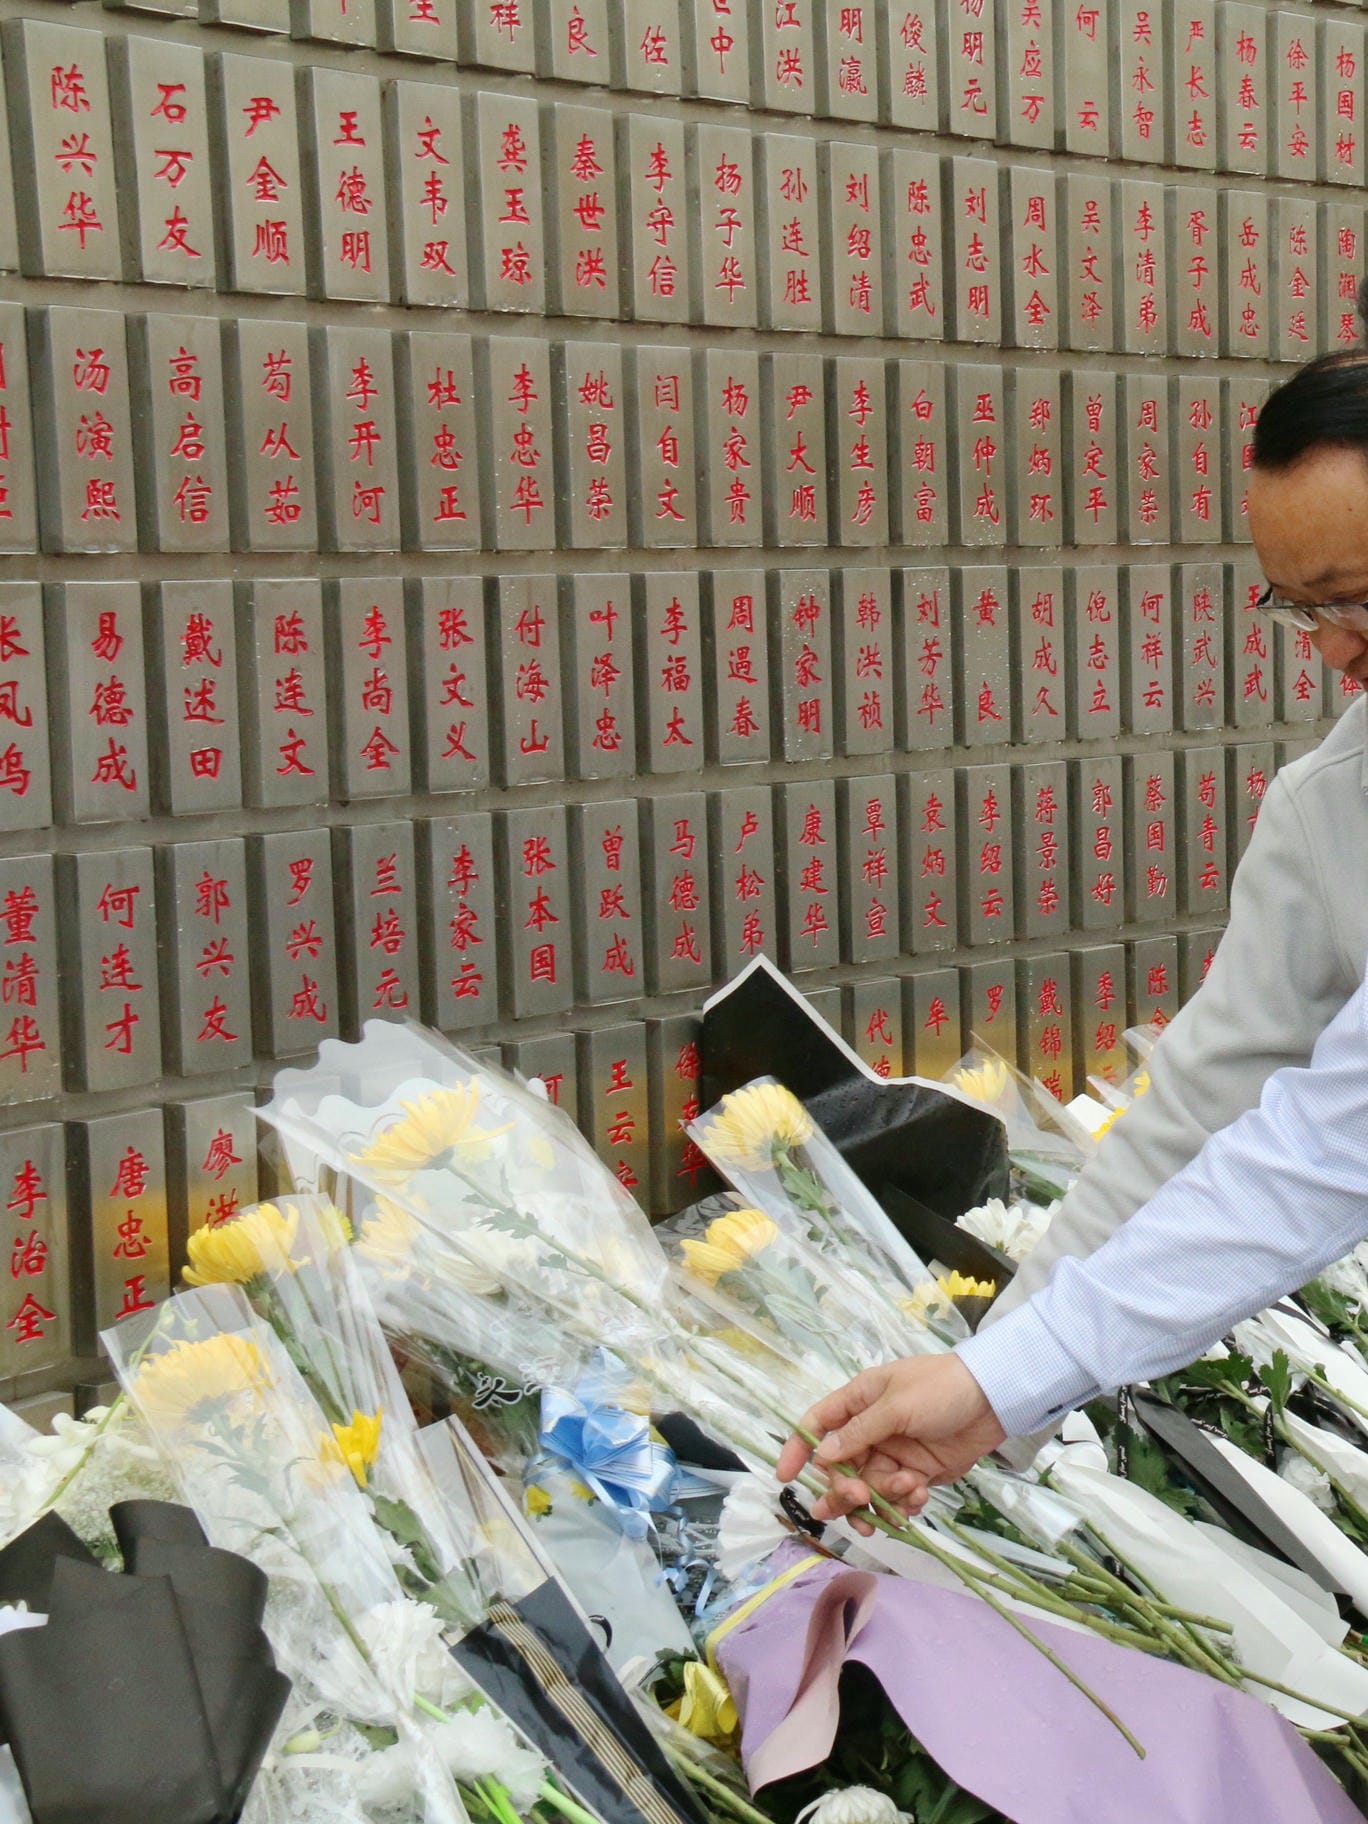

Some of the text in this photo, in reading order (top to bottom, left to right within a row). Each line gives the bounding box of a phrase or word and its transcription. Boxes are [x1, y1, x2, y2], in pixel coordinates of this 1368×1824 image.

[1075, 4, 1101, 132] 何云
[1132, 11, 1155, 141] 吴永智
[1184, 20, 1209, 148] 严长志
[1235, 31, 1259, 151] 杨春云
[1286, 39, 1310, 159] 徐平安
[1334, 47, 1356, 167] 杨国材
[50, 65, 104, 250] 陈兴华
[149, 83, 202, 258] 石万友
[242, 97, 291, 265] 尹金顺
[332, 112, 373, 273] 王德明
[416, 117, 457, 276] 文韦双
[496, 124, 533, 285] 龚玉琼
[569, 134, 607, 292] 秦世洪
[644, 142, 678, 296] 李守信
[779, 167, 812, 305] 孙连胜
[845, 173, 873, 314] 刘绍清
[908, 178, 936, 318] 陈忠武
[964, 187, 990, 319] 刘志明
[1023, 196, 1051, 326] 周水全
[1080, 200, 1103, 323] 吴文泽
[1134, 201, 1157, 334] 李清弟
[1186, 210, 1212, 338] 胥子成
[1238, 217, 1262, 338] 岳成忠
[1336, 228, 1359, 345] 陶润琴
[73, 349, 121, 522] 汤演熙
[168, 347, 212, 524] 高启信
[345, 357, 385, 525] 李开河
[427, 368, 468, 523] 杜忠正
[508, 364, 544, 526] 李忠华
[578, 369, 615, 521] 姚昌荣
[654, 375, 685, 521] 闫自文
[721, 376, 751, 525] 杨家贵
[784, 385, 816, 522] 尹大顺
[848, 379, 877, 525] 李生彦
[911, 389, 937, 524] 白朝富
[972, 393, 1000, 525] 巫仲成
[1083, 394, 1109, 524] 曾定平
[1137, 400, 1160, 524] 周家荣
[1188, 399, 1213, 522] 孙自有
[88, 612, 138, 793] 易德成
[179, 614, 225, 781] 戴述田
[273, 611, 316, 777] 陈连文
[358, 606, 400, 771] 李尚全
[438, 609, 477, 762] 张文义
[513, 606, 551, 756] 付海山
[588, 601, 622, 752] 叶泽忠
[660, 597, 693, 747] 李福太
[725, 594, 760, 737] 周遇春
[791, 595, 823, 734] 钟家明
[855, 593, 884, 731] 韩洪祯
[916, 591, 944, 727] 刘芳华
[973, 588, 1003, 724] 黄良
[1031, 593, 1059, 717] 胡成久
[1085, 592, 1112, 714] 倪志立
[1140, 592, 1165, 709] 何祥云
[1242, 584, 1268, 703] 王成武
[598, 826, 635, 979] 曾跃成
[669, 819, 703, 965] 马德成
[735, 811, 766, 957] 卢松弟
[799, 804, 829, 945] 康建华
[862, 798, 889, 940] 覃祥宣
[920, 793, 947, 928] 袁炳文
[978, 789, 1004, 918] 李绍云
[1034, 784, 1059, 916] 蒋景荣
[1091, 779, 1116, 906] 郭昌好
[1143, 774, 1167, 896] 蔡国勤
[0, 886, 46, 1073] 董清华
[96, 884, 143, 1056] 何连才
[194, 872, 239, 1043] 郭兴友
[285, 859, 327, 1024] 罗兴成
[369, 854, 409, 1009] 兰培元
[447, 844, 484, 1000] 李家云
[523, 837, 560, 985] 张本国
[5, 1161, 57, 1344] 李治全
[108, 1147, 157, 1320] 唐忠正
